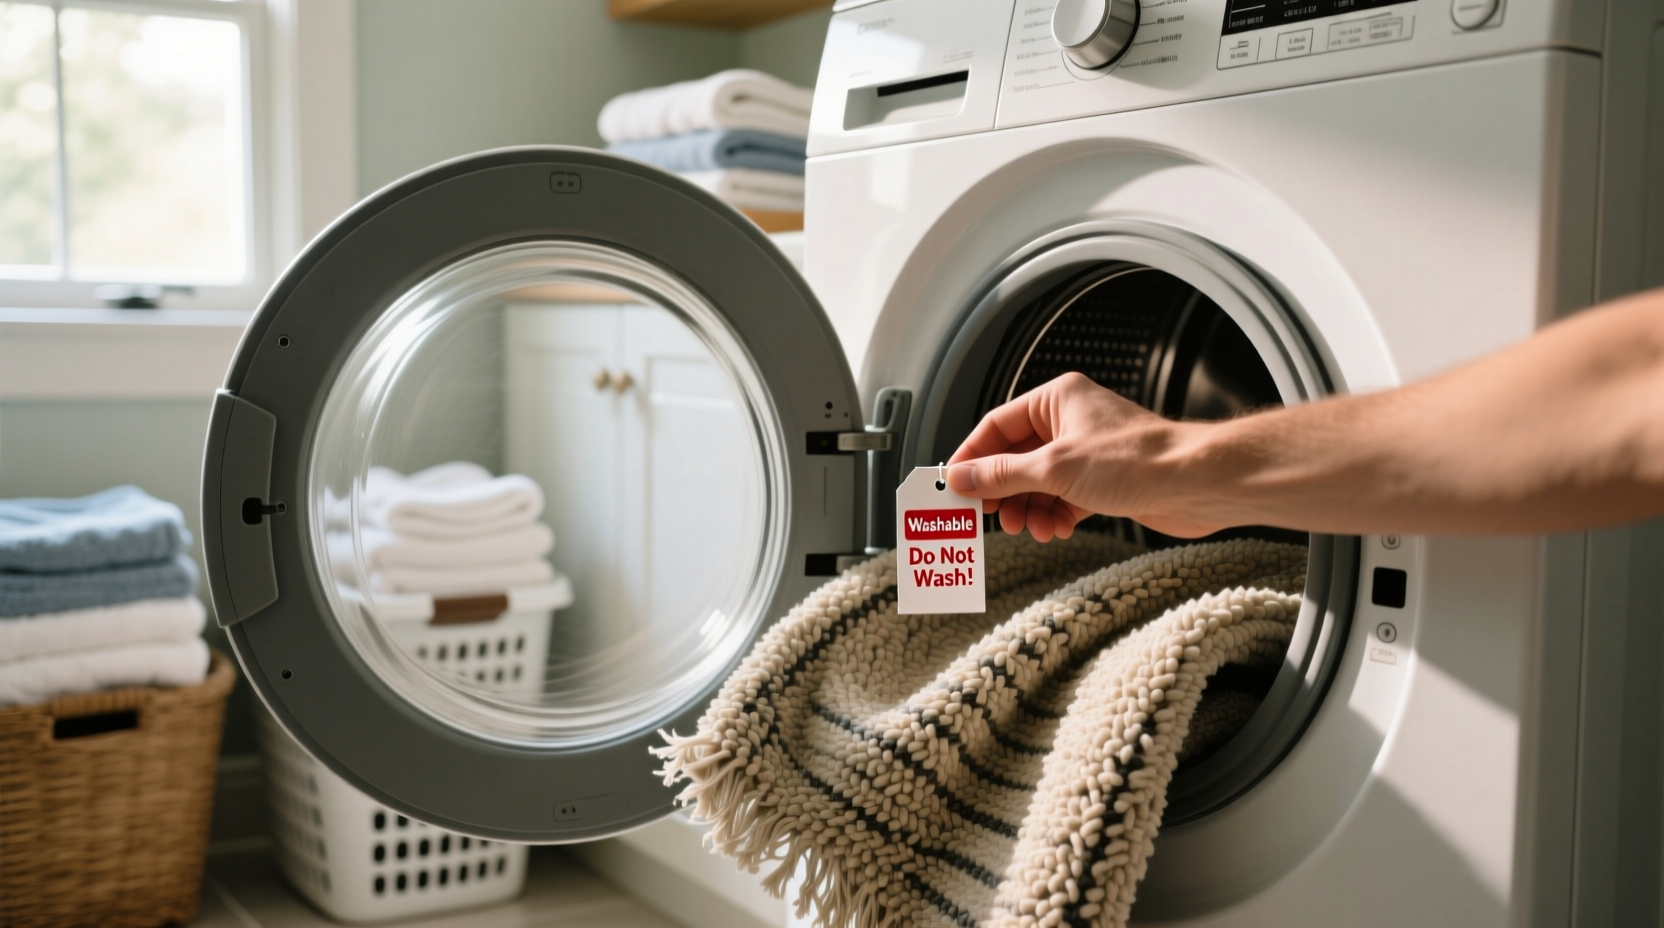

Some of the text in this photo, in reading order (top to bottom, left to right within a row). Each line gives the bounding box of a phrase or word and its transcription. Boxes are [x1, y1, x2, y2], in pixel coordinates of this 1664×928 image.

[908, 515, 973, 532] Washable
[909, 546, 975, 565] Do Not
[914, 567, 973, 587] Wash!
